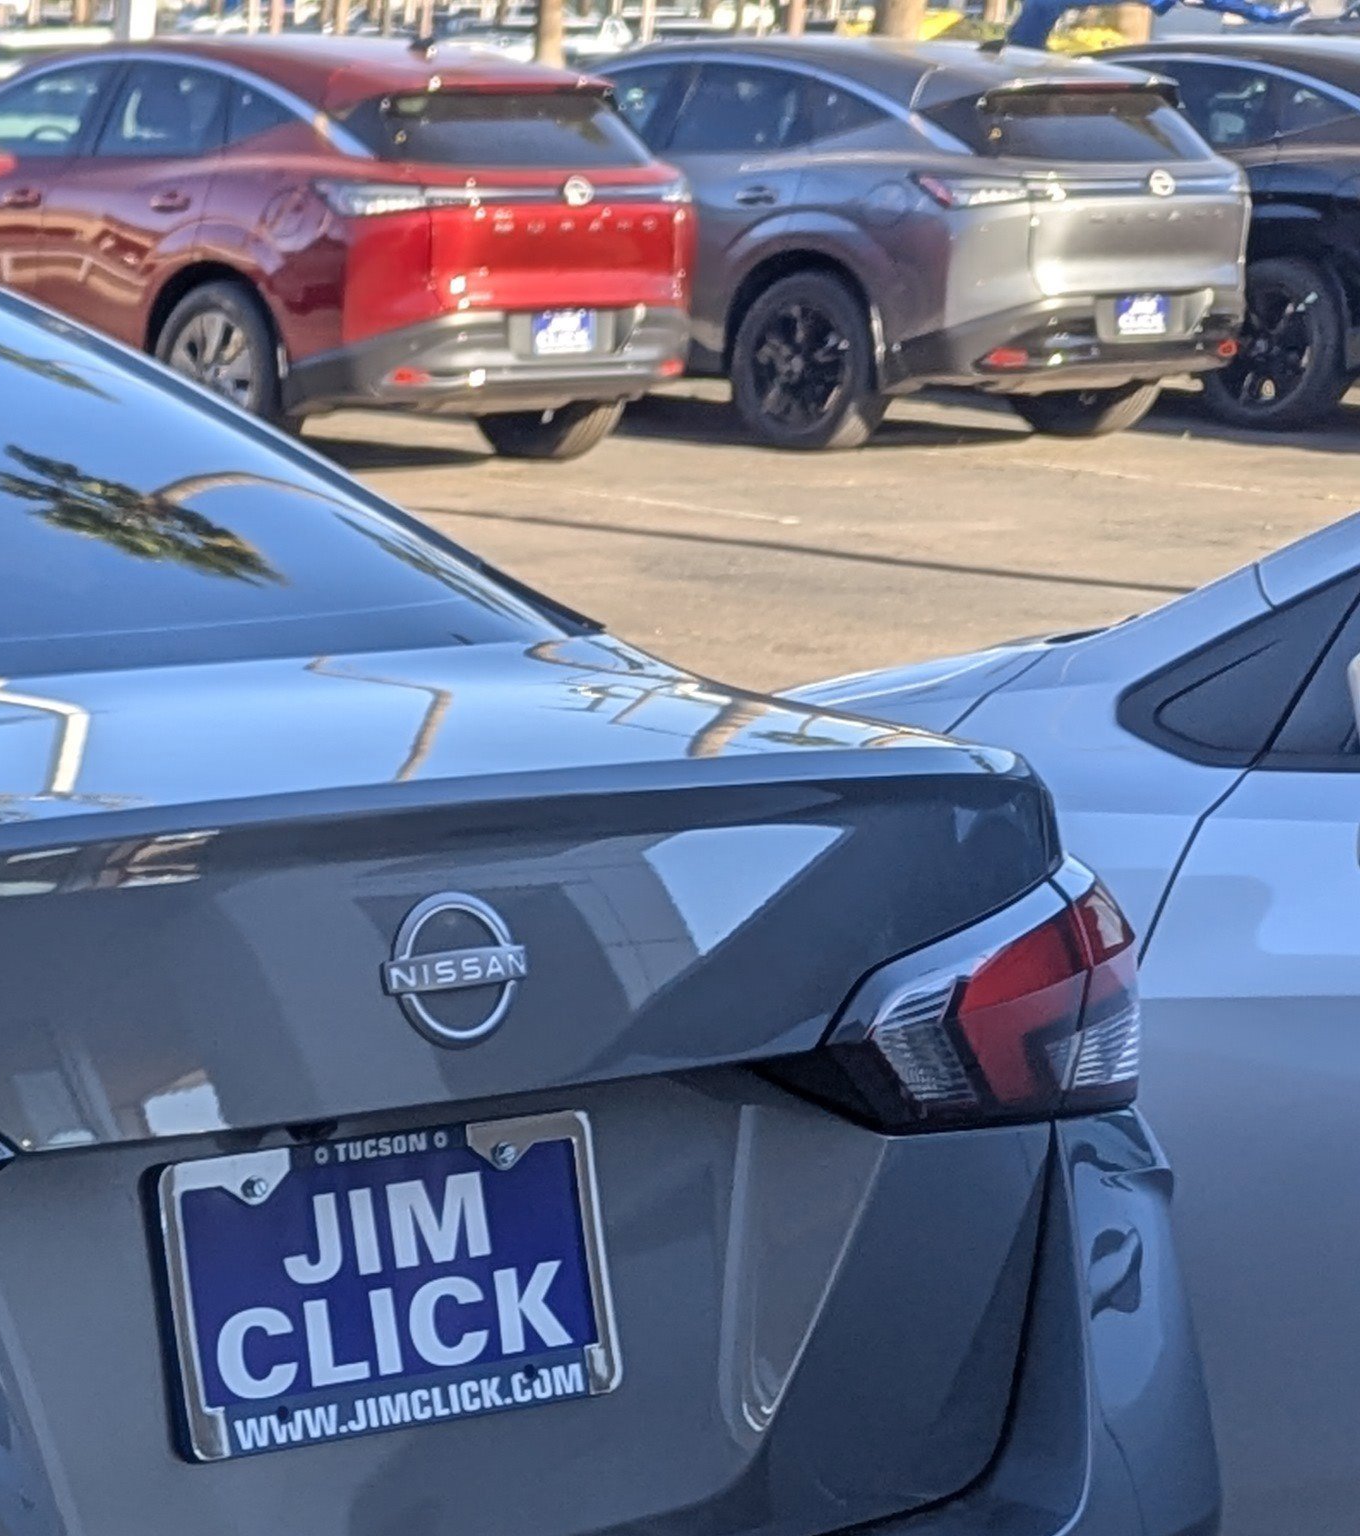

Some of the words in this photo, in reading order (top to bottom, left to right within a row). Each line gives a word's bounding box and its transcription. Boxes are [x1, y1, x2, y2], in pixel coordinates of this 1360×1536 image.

[389, 953, 527, 990] NISSAN
[335, 1132, 428, 1162] TUCSON
[283, 1171, 492, 1285] JIM
[216, 1260, 574, 1400] CLICK
[233, 1363, 586, 1451] WWW.JIMCLICK.COM
